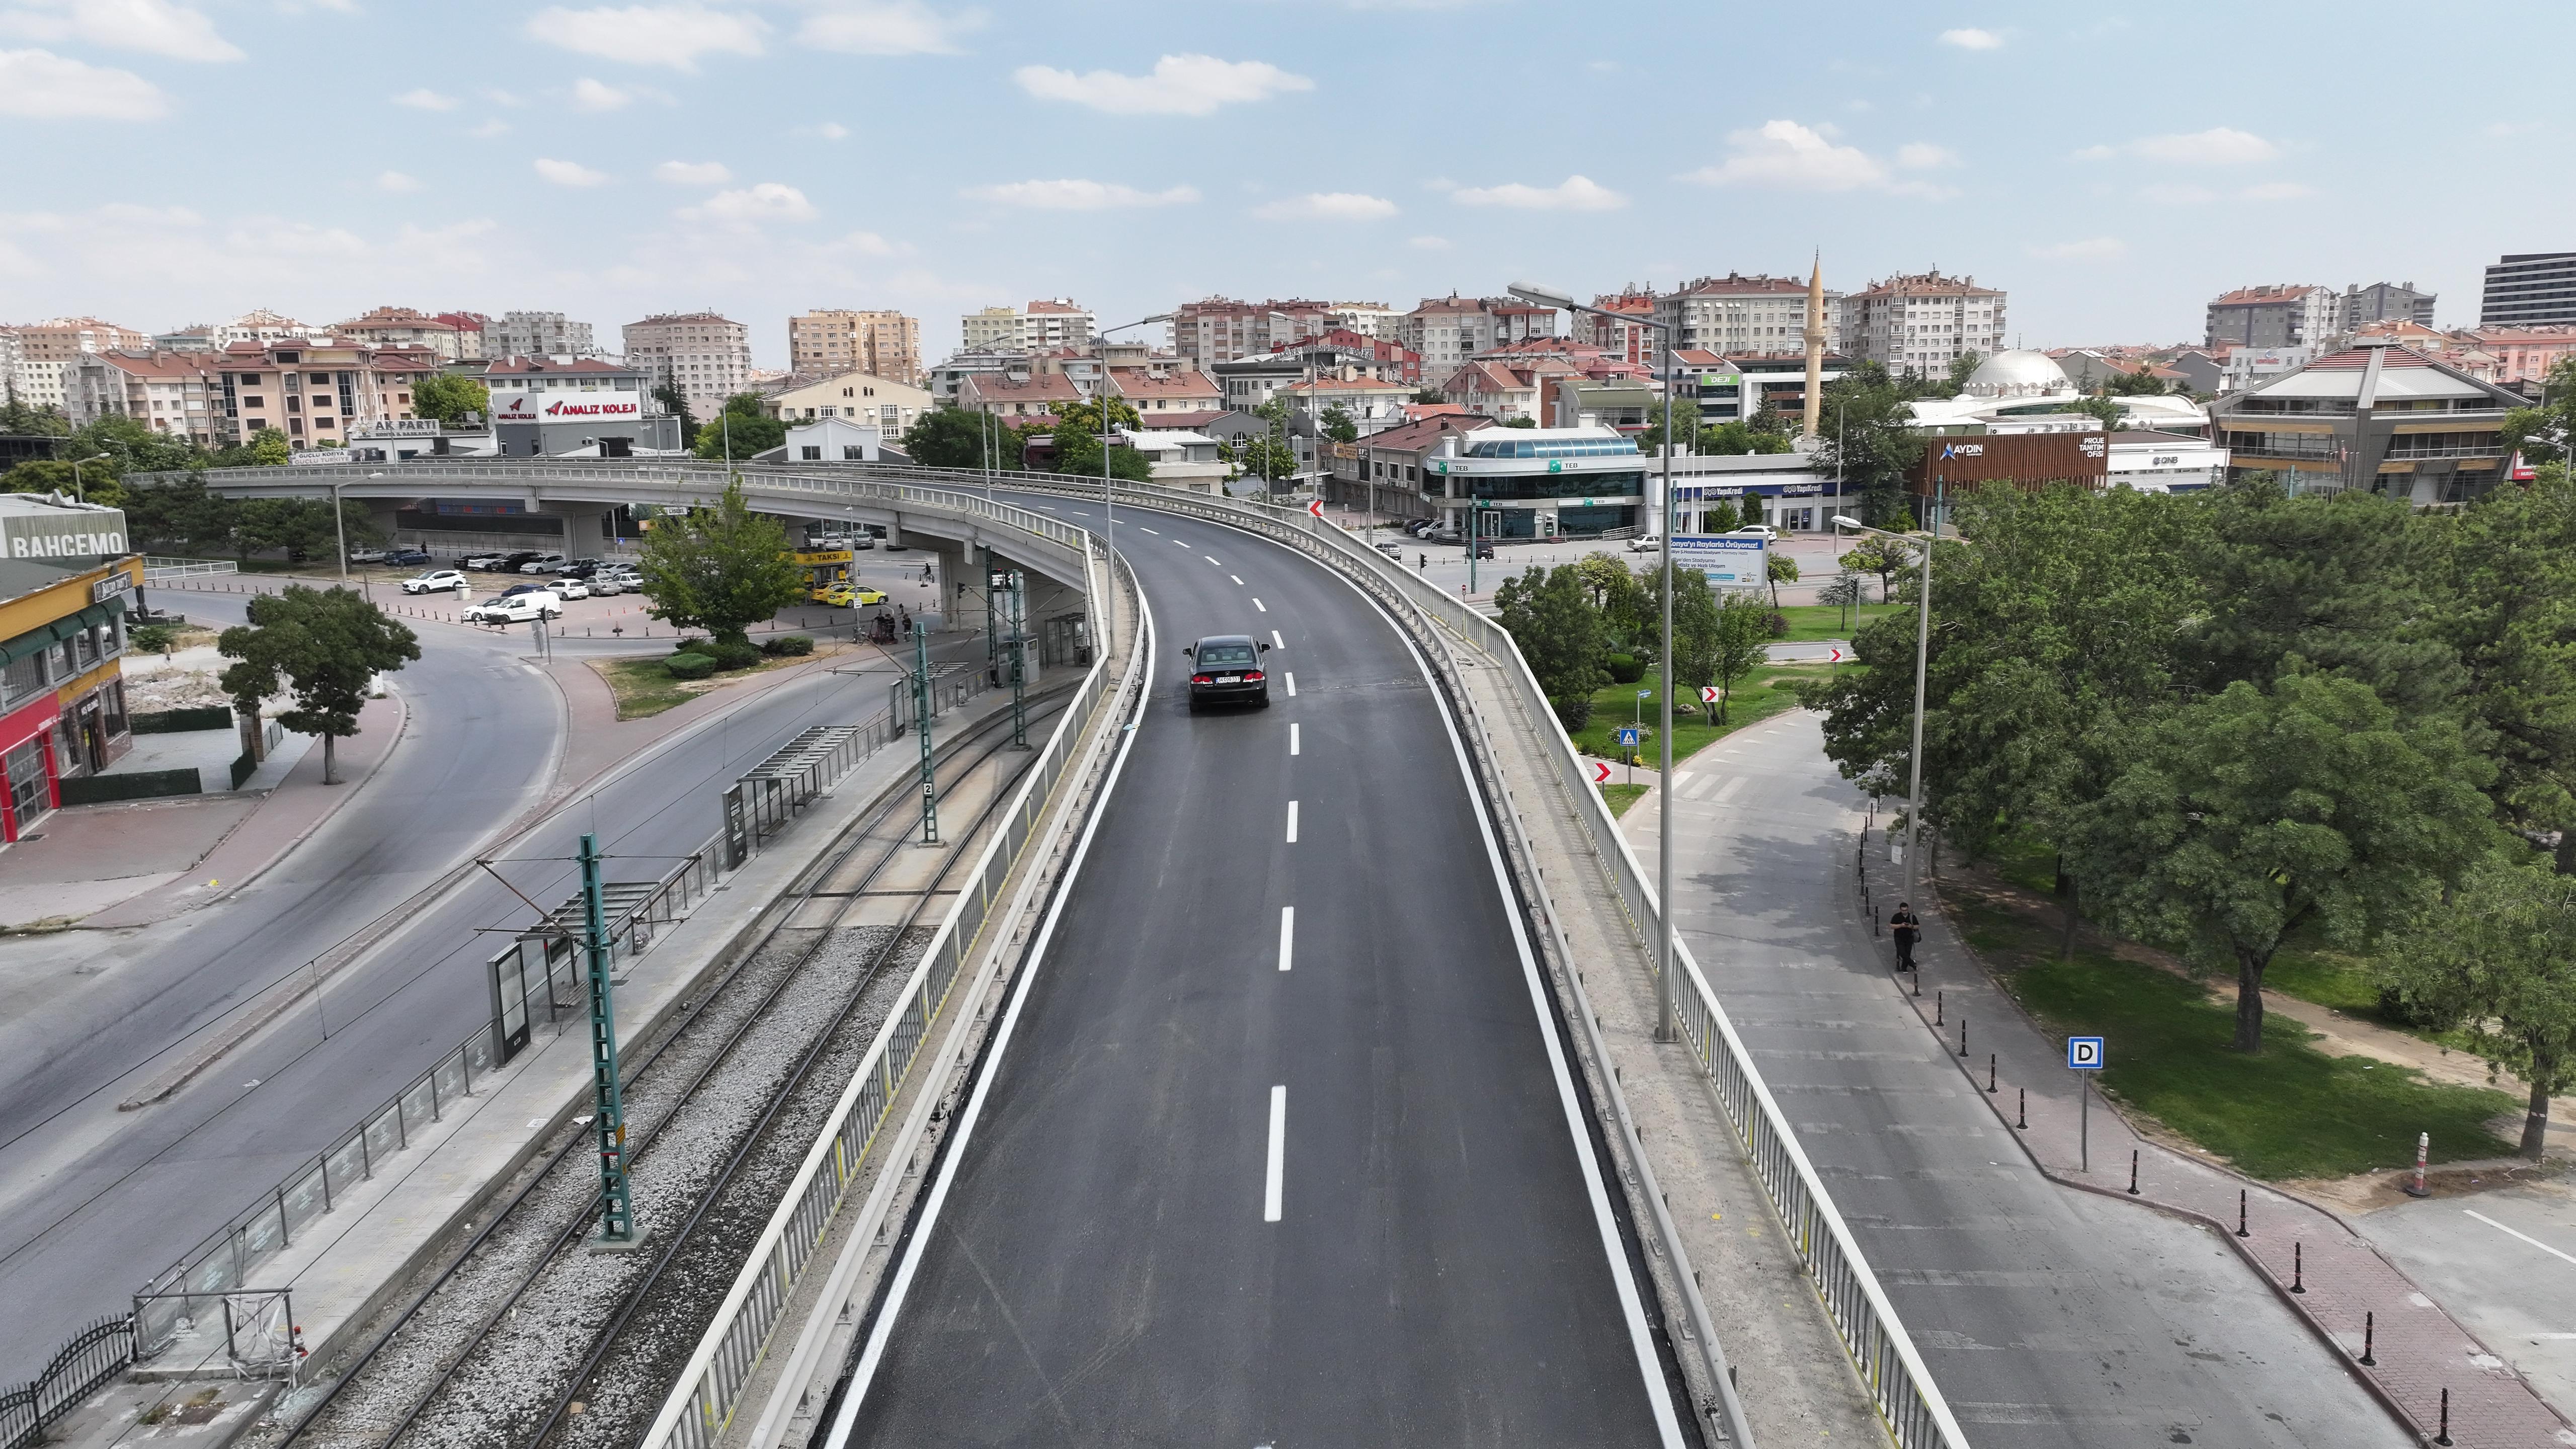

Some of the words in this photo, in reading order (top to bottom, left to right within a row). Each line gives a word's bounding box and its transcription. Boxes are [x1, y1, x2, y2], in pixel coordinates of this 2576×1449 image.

[376, 421, 394, 430] AK
[1954, 445, 1983, 453] AYDIN
[1726, 541, 1758, 549] Örüyoruz!
[926, 785, 931, 793] 2
[2078, 1044, 2093, 1061] D
